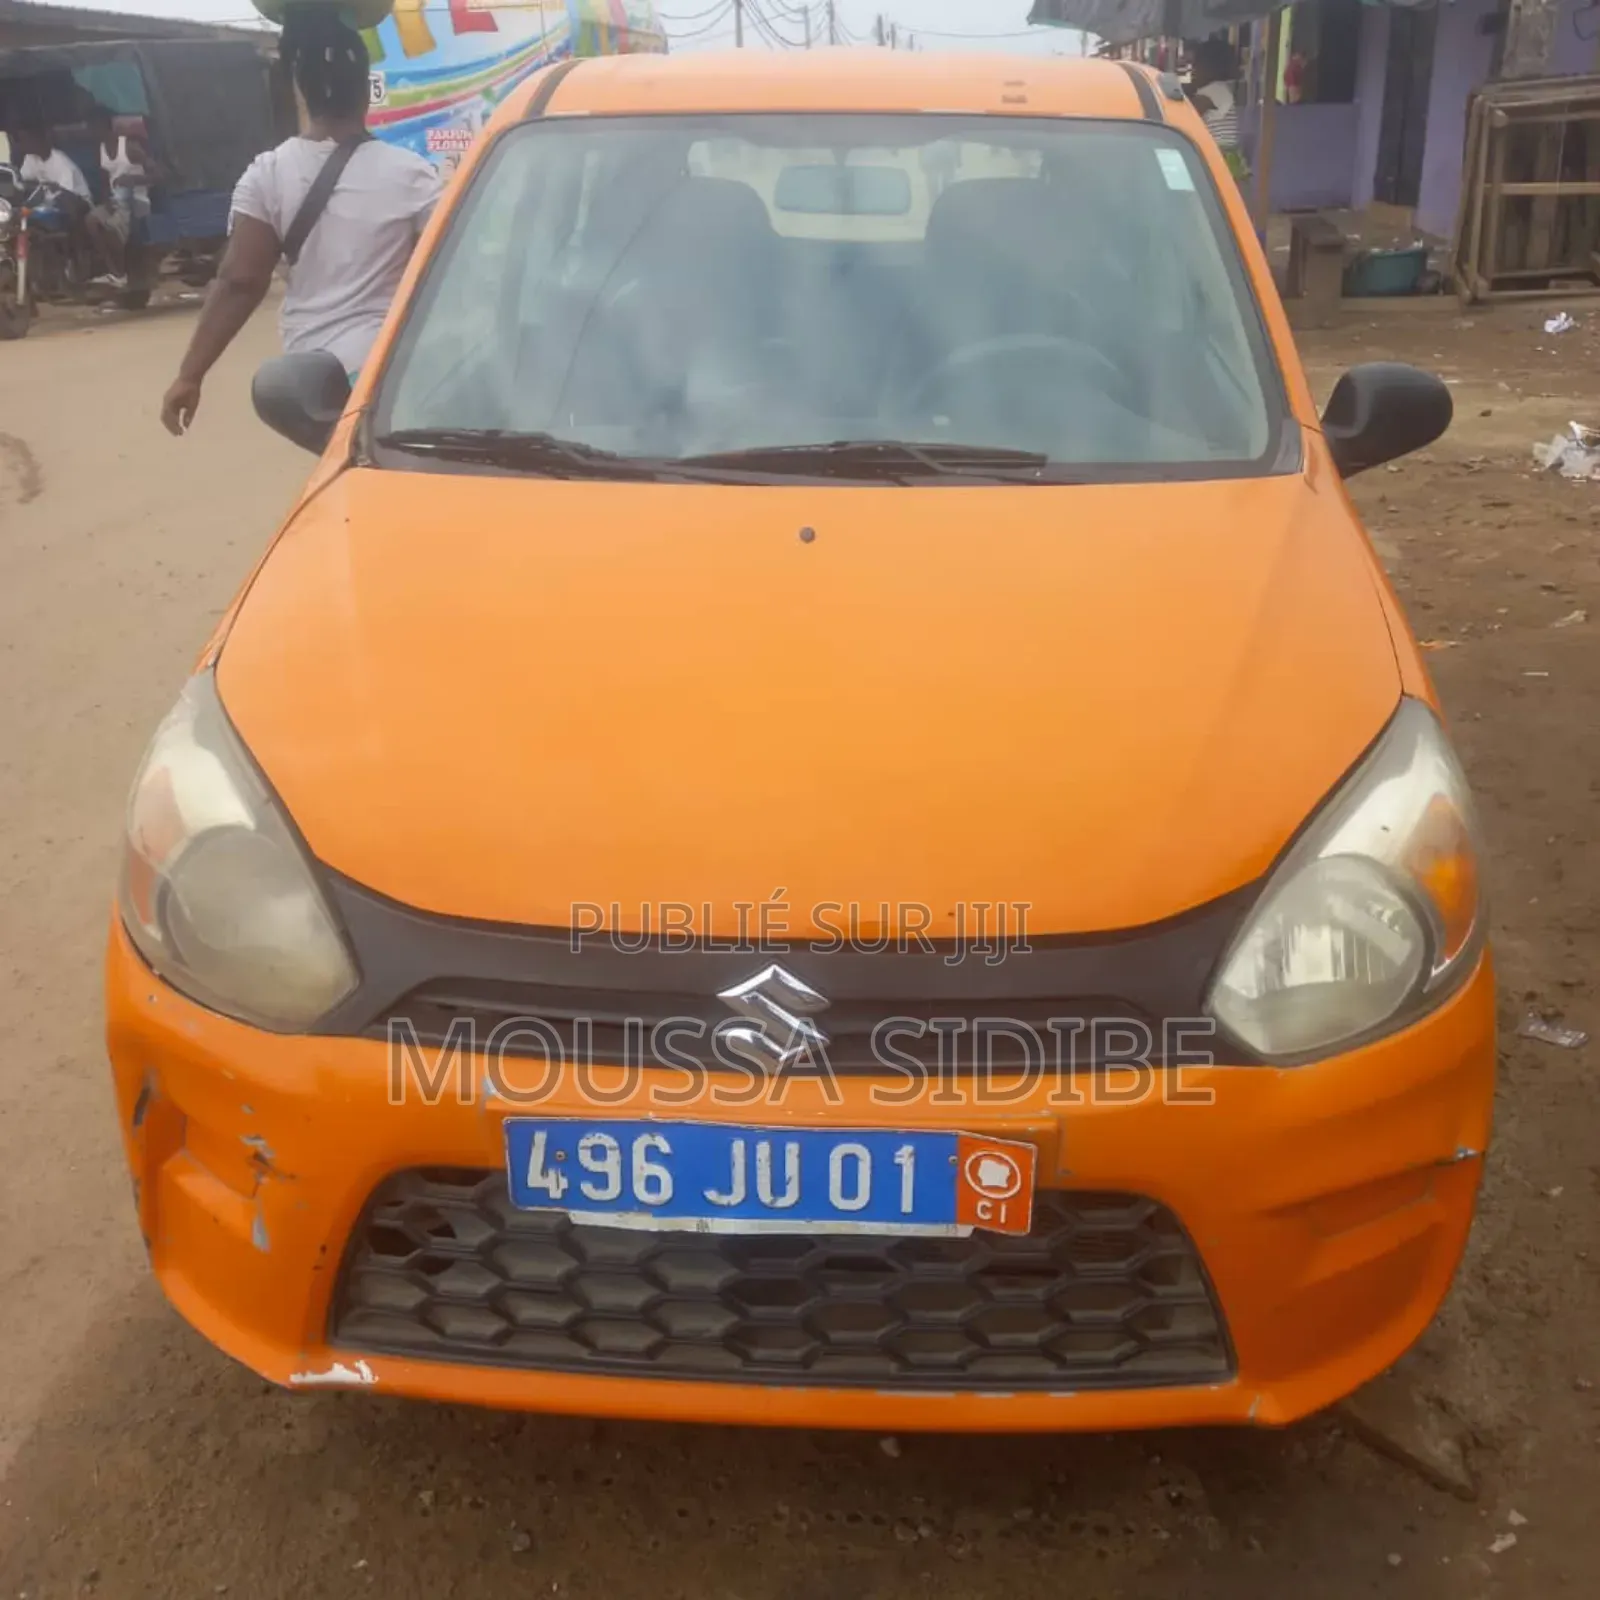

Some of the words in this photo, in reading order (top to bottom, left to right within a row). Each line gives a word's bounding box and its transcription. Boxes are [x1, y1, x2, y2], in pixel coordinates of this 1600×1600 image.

[527, 1130, 674, 1206] 496
[703, 1138, 800, 1209] JU
[829, 1143, 915, 1214] 01
[976, 1199, 1007, 1224] CI
